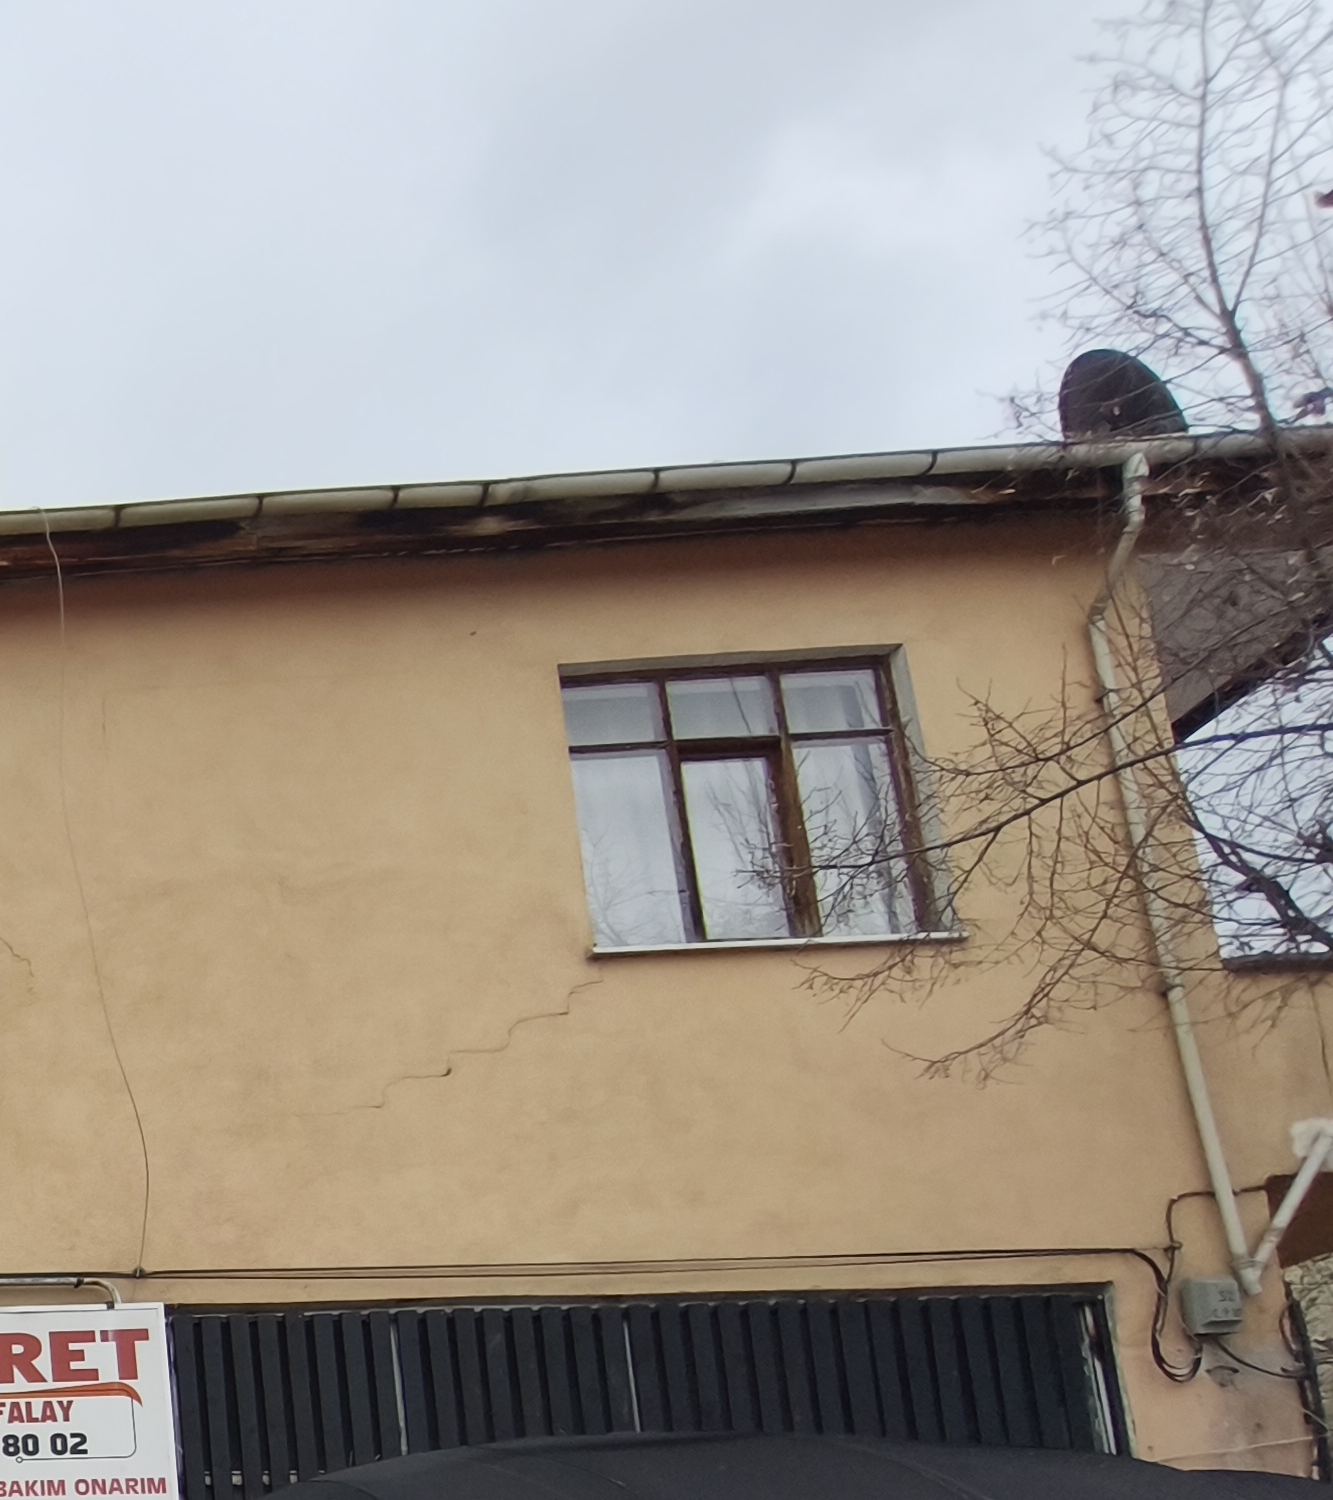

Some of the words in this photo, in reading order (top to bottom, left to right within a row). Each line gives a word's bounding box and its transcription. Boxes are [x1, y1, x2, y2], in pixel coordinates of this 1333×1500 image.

[2, 1433, 39, 1457] 80
[50, 1432, 89, 1456] 02
[74, 1477, 167, 1496] ONARIM
